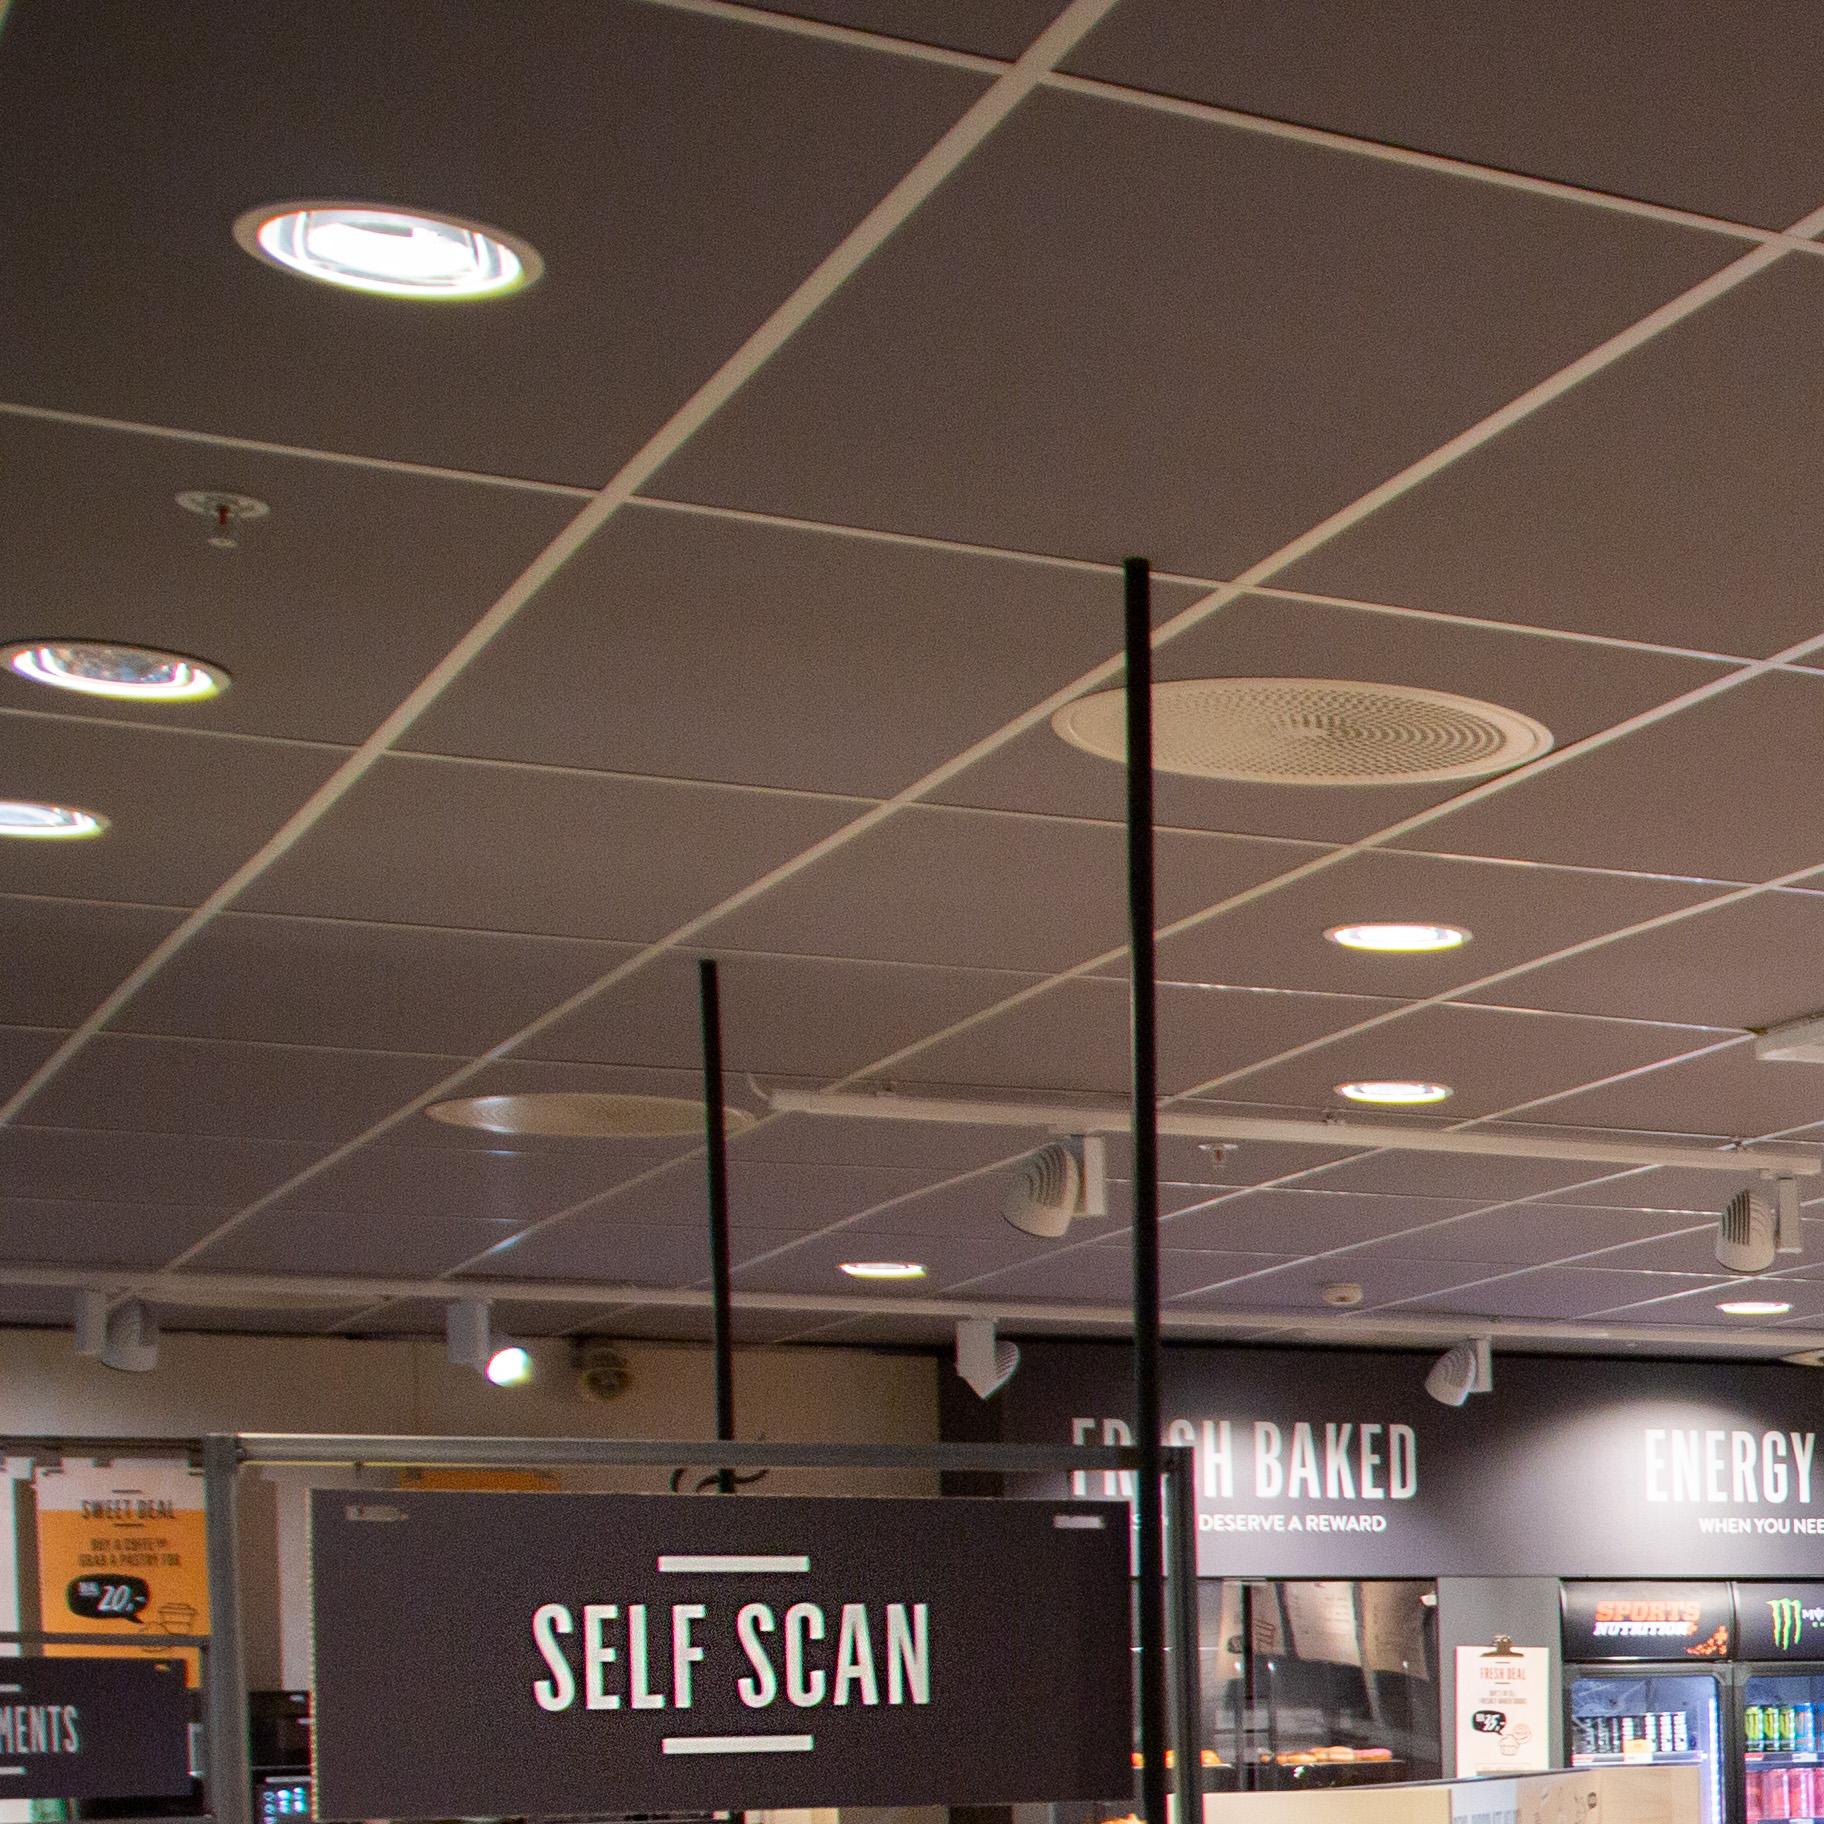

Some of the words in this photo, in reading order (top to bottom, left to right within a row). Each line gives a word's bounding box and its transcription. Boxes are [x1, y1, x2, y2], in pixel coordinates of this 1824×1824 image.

[1253, 1420, 1417, 1500] BAKED
[1644, 1429, 1815, 1504] ENERGY
[1198, 1514, 1285, 1532] DESERVE
[1287, 1514, 1303, 1531] A
[1306, 1514, 1386, 1533] REWARD
[1699, 1518, 1750, 1534] WHEN
[1753, 1518, 1790, 1534] YOU
[1595, 1600, 1701, 1621] SPORTS
[532, 1603, 708, 1712] SELF
[737, 1603, 930, 1708] SCAN
